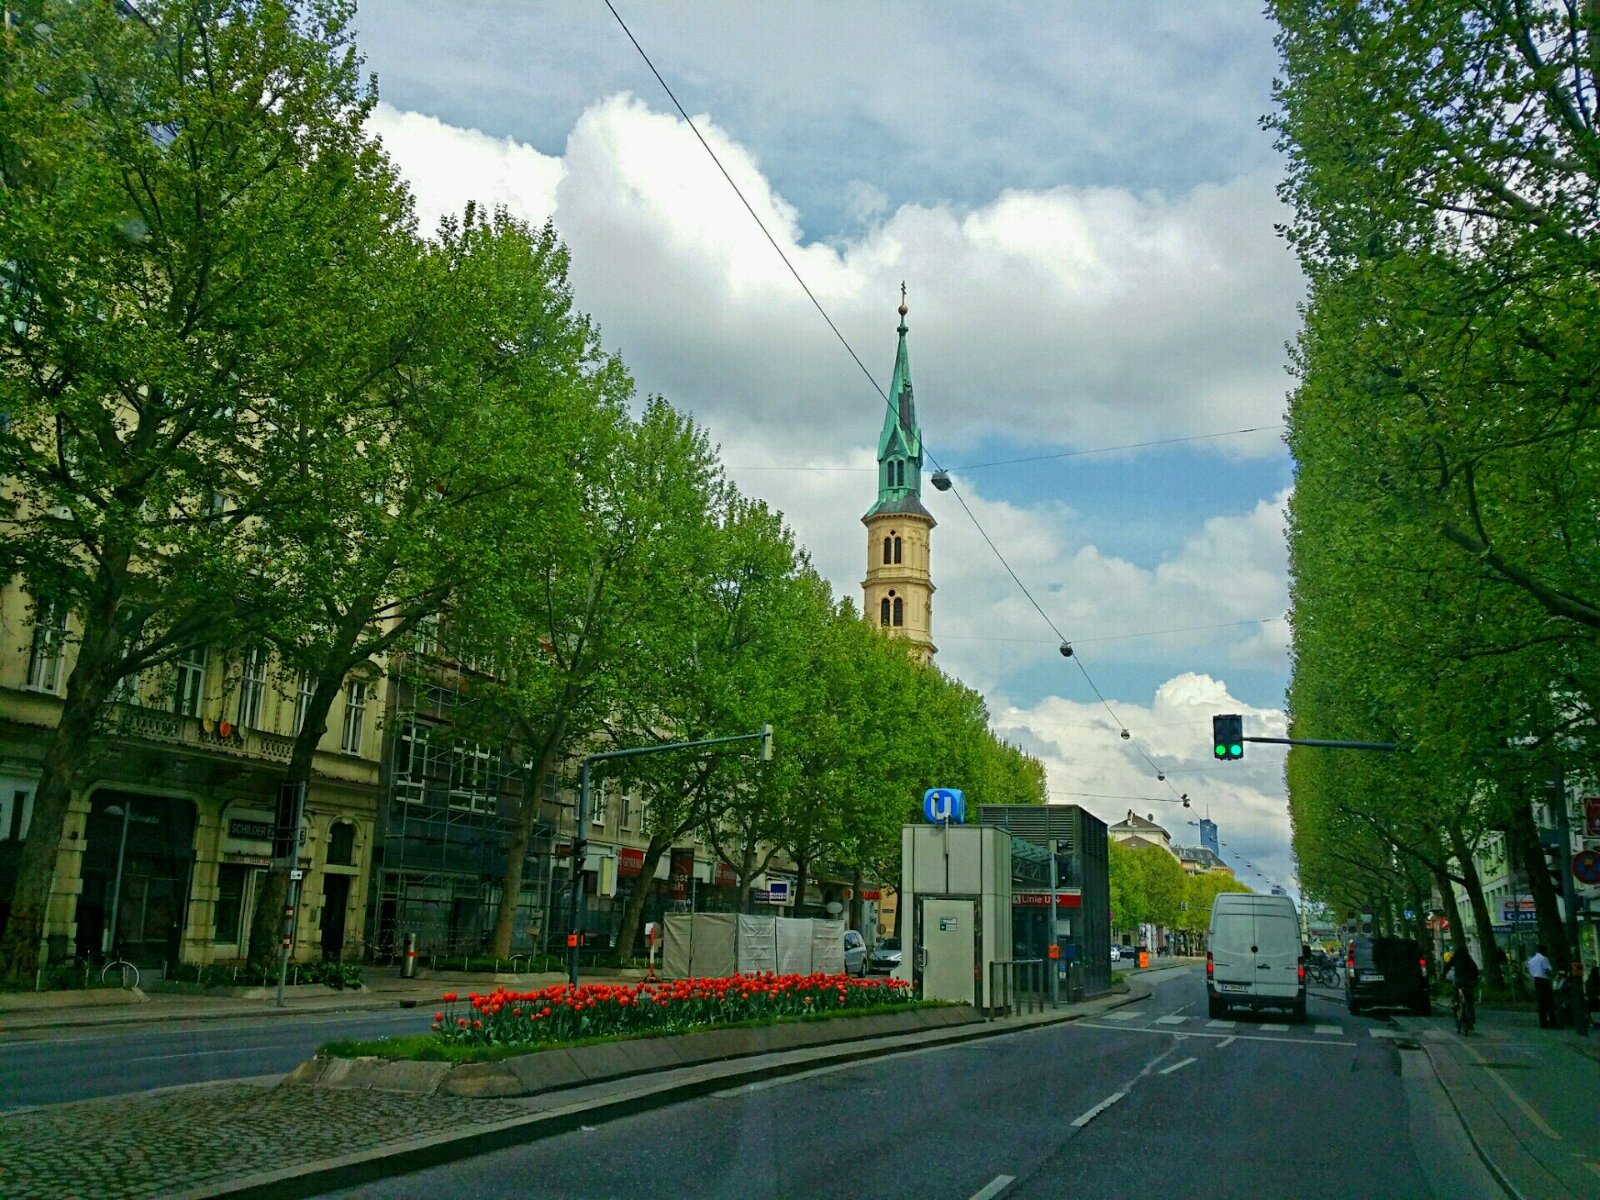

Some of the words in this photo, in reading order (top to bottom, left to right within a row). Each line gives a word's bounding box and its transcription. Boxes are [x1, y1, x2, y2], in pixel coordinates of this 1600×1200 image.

[930, 796, 952, 820] U
[231, 822, 267, 837] SCHILDER
[1021, 895, 1042, 904] Linie
